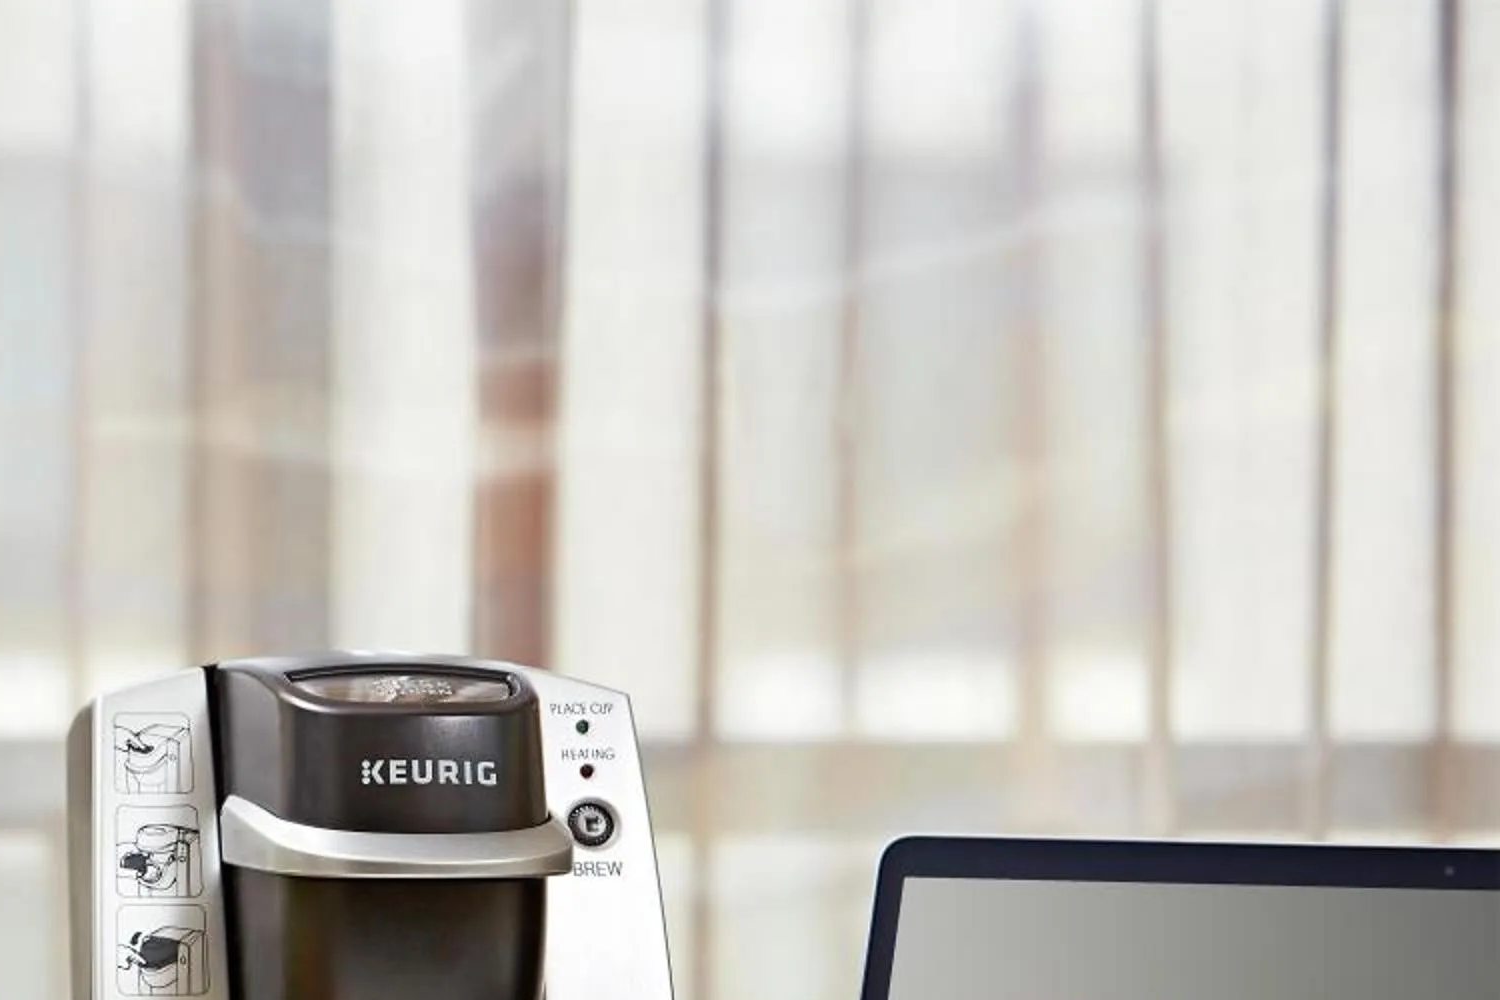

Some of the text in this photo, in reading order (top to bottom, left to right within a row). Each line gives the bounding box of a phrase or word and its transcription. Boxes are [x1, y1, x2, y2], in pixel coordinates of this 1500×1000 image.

[550, 703, 614, 715] PLACE CUP
[561, 748, 617, 760] HEATING
[361, 757, 498, 786] KEURIG
[573, 861, 623, 878] BREW
